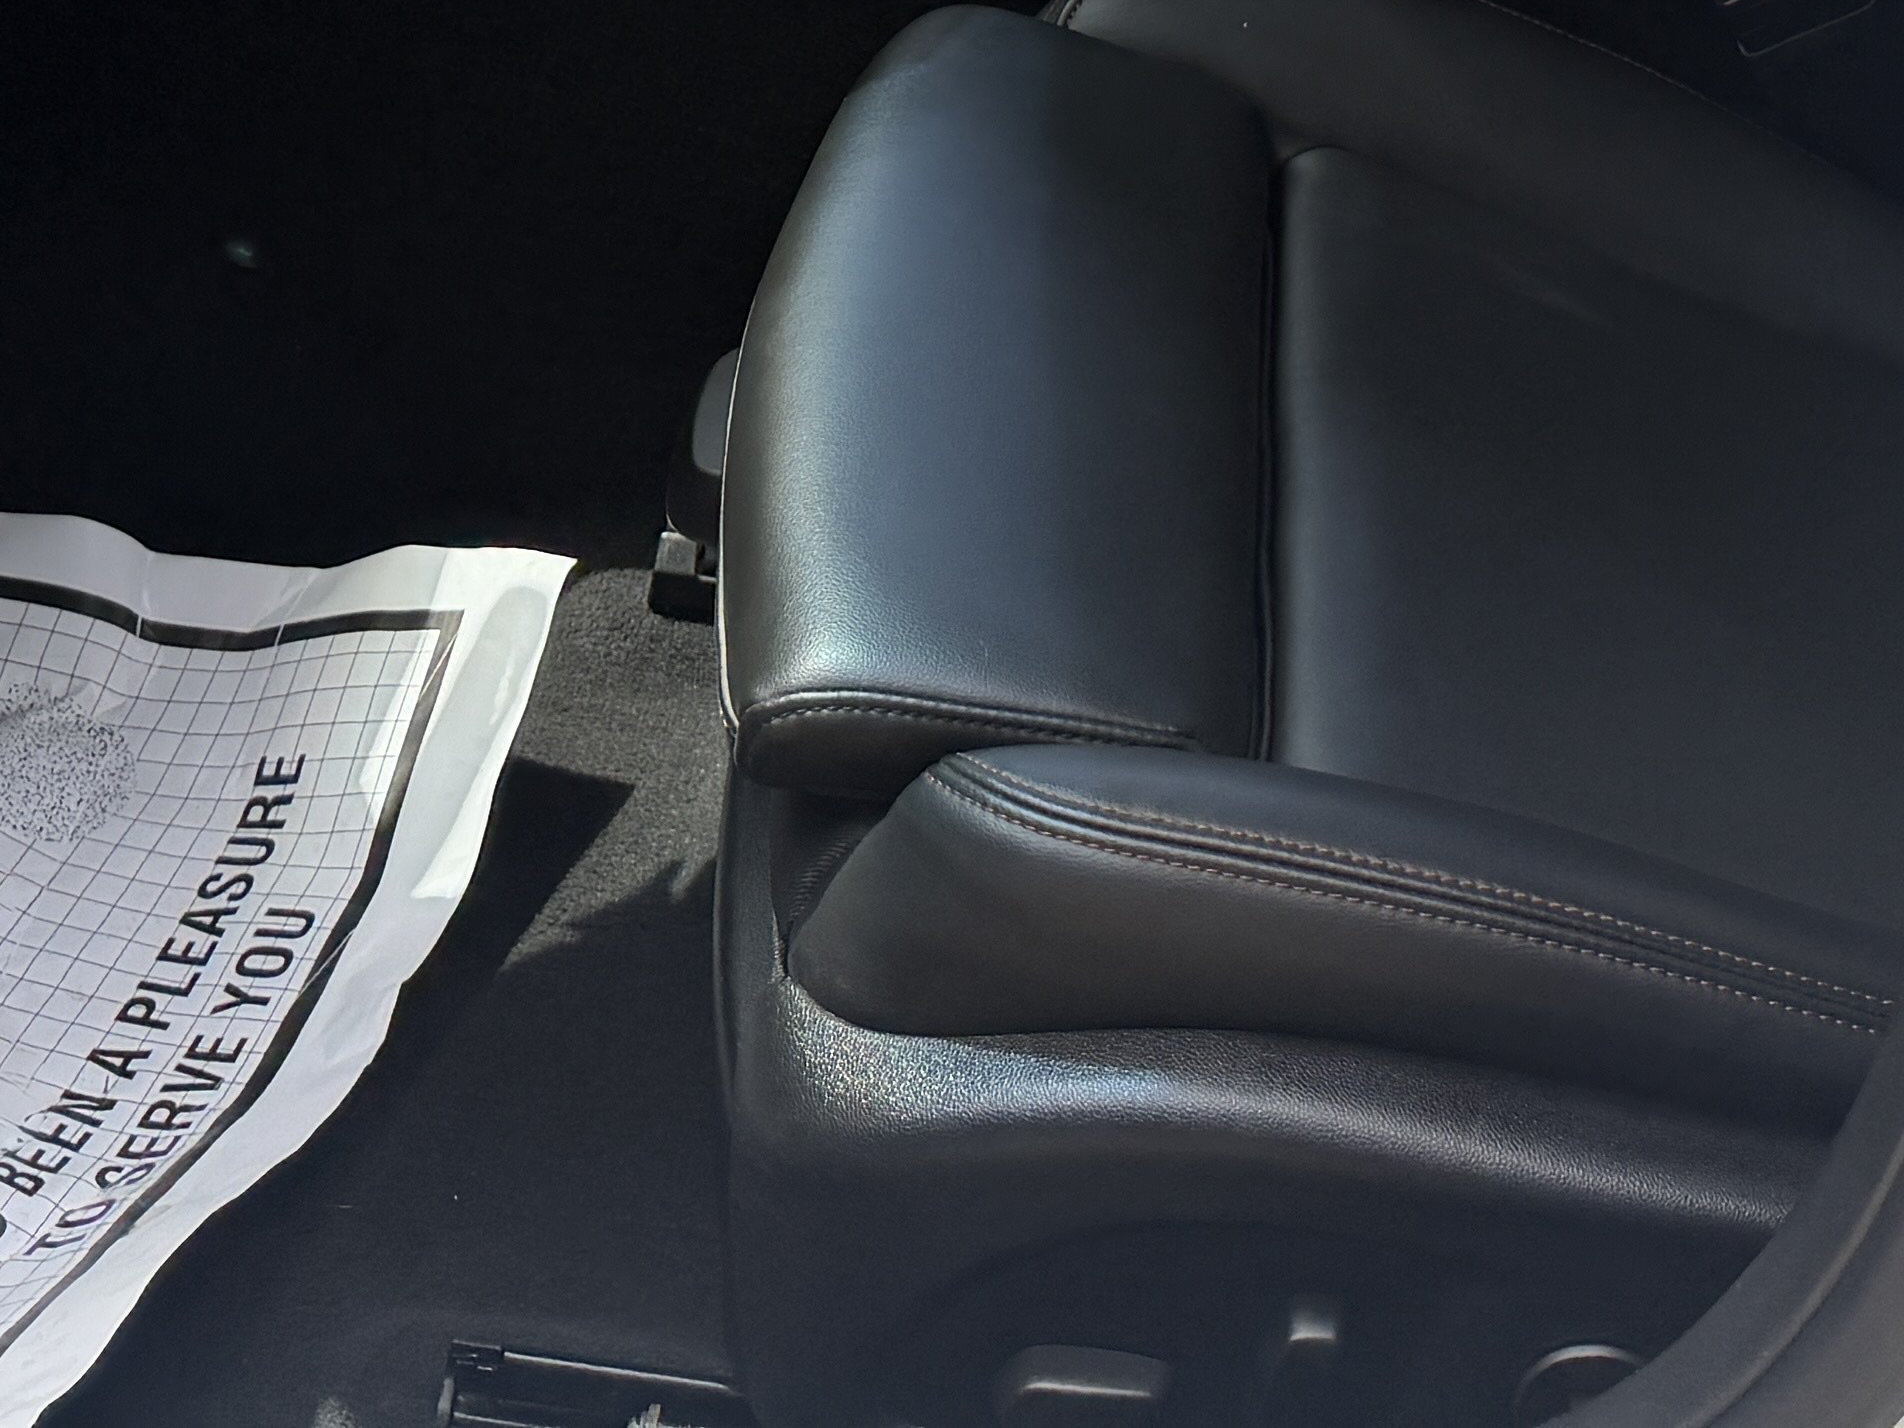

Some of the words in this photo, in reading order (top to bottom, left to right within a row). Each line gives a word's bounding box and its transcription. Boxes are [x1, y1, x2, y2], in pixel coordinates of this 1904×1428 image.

[116, 752, 307, 1031] PLEASURE
[24, 1197, 116, 1257] TO
[94, 1034, 250, 1191] SERVE
[211, 907, 316, 1017] YOU
[86, 1048, 153, 1081] A
